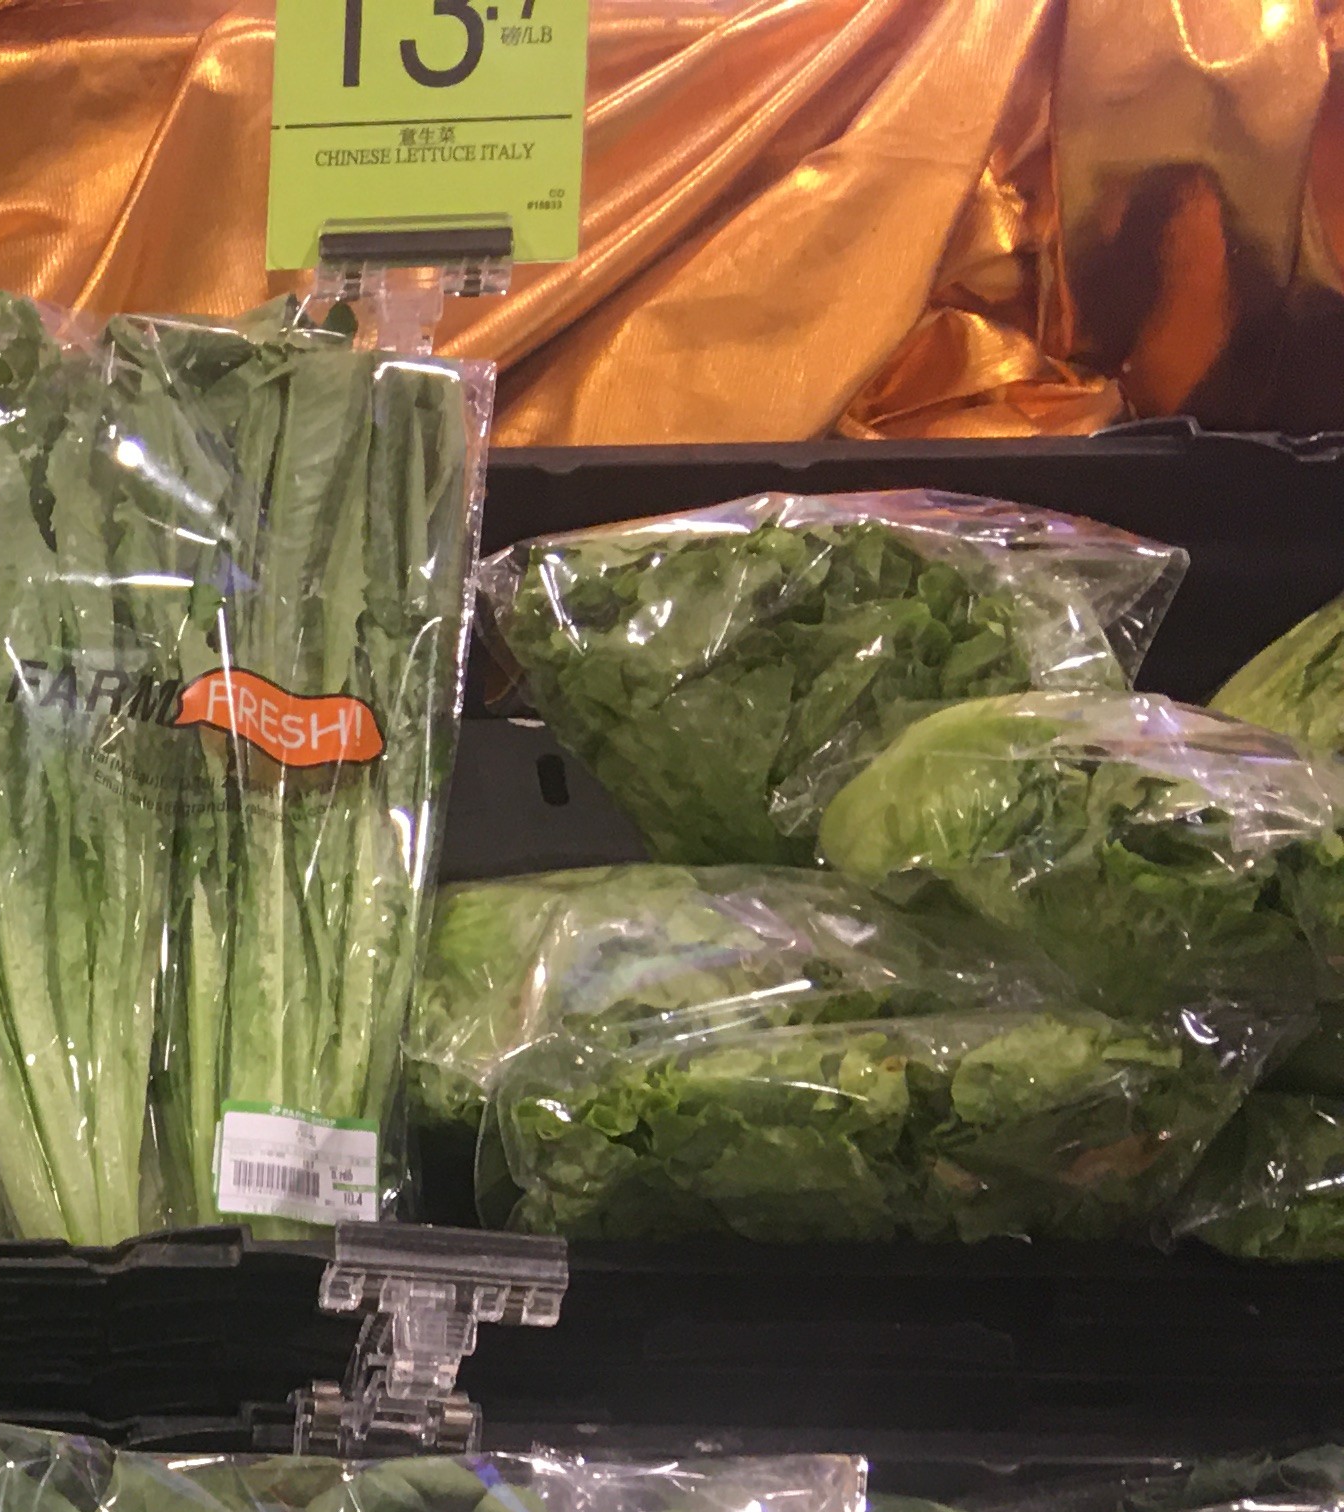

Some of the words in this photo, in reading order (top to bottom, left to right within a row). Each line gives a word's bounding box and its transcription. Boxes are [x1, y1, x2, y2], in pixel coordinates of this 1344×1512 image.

[343, 0, 535, 88] 13.
[315, 149, 391, 167] CHINESE
[395, 145, 476, 164] LETTUCE
[480, 142, 536, 162] ITALY
[6, 659, 182, 726] FARM
[208, 680, 364, 750] FRESH!
